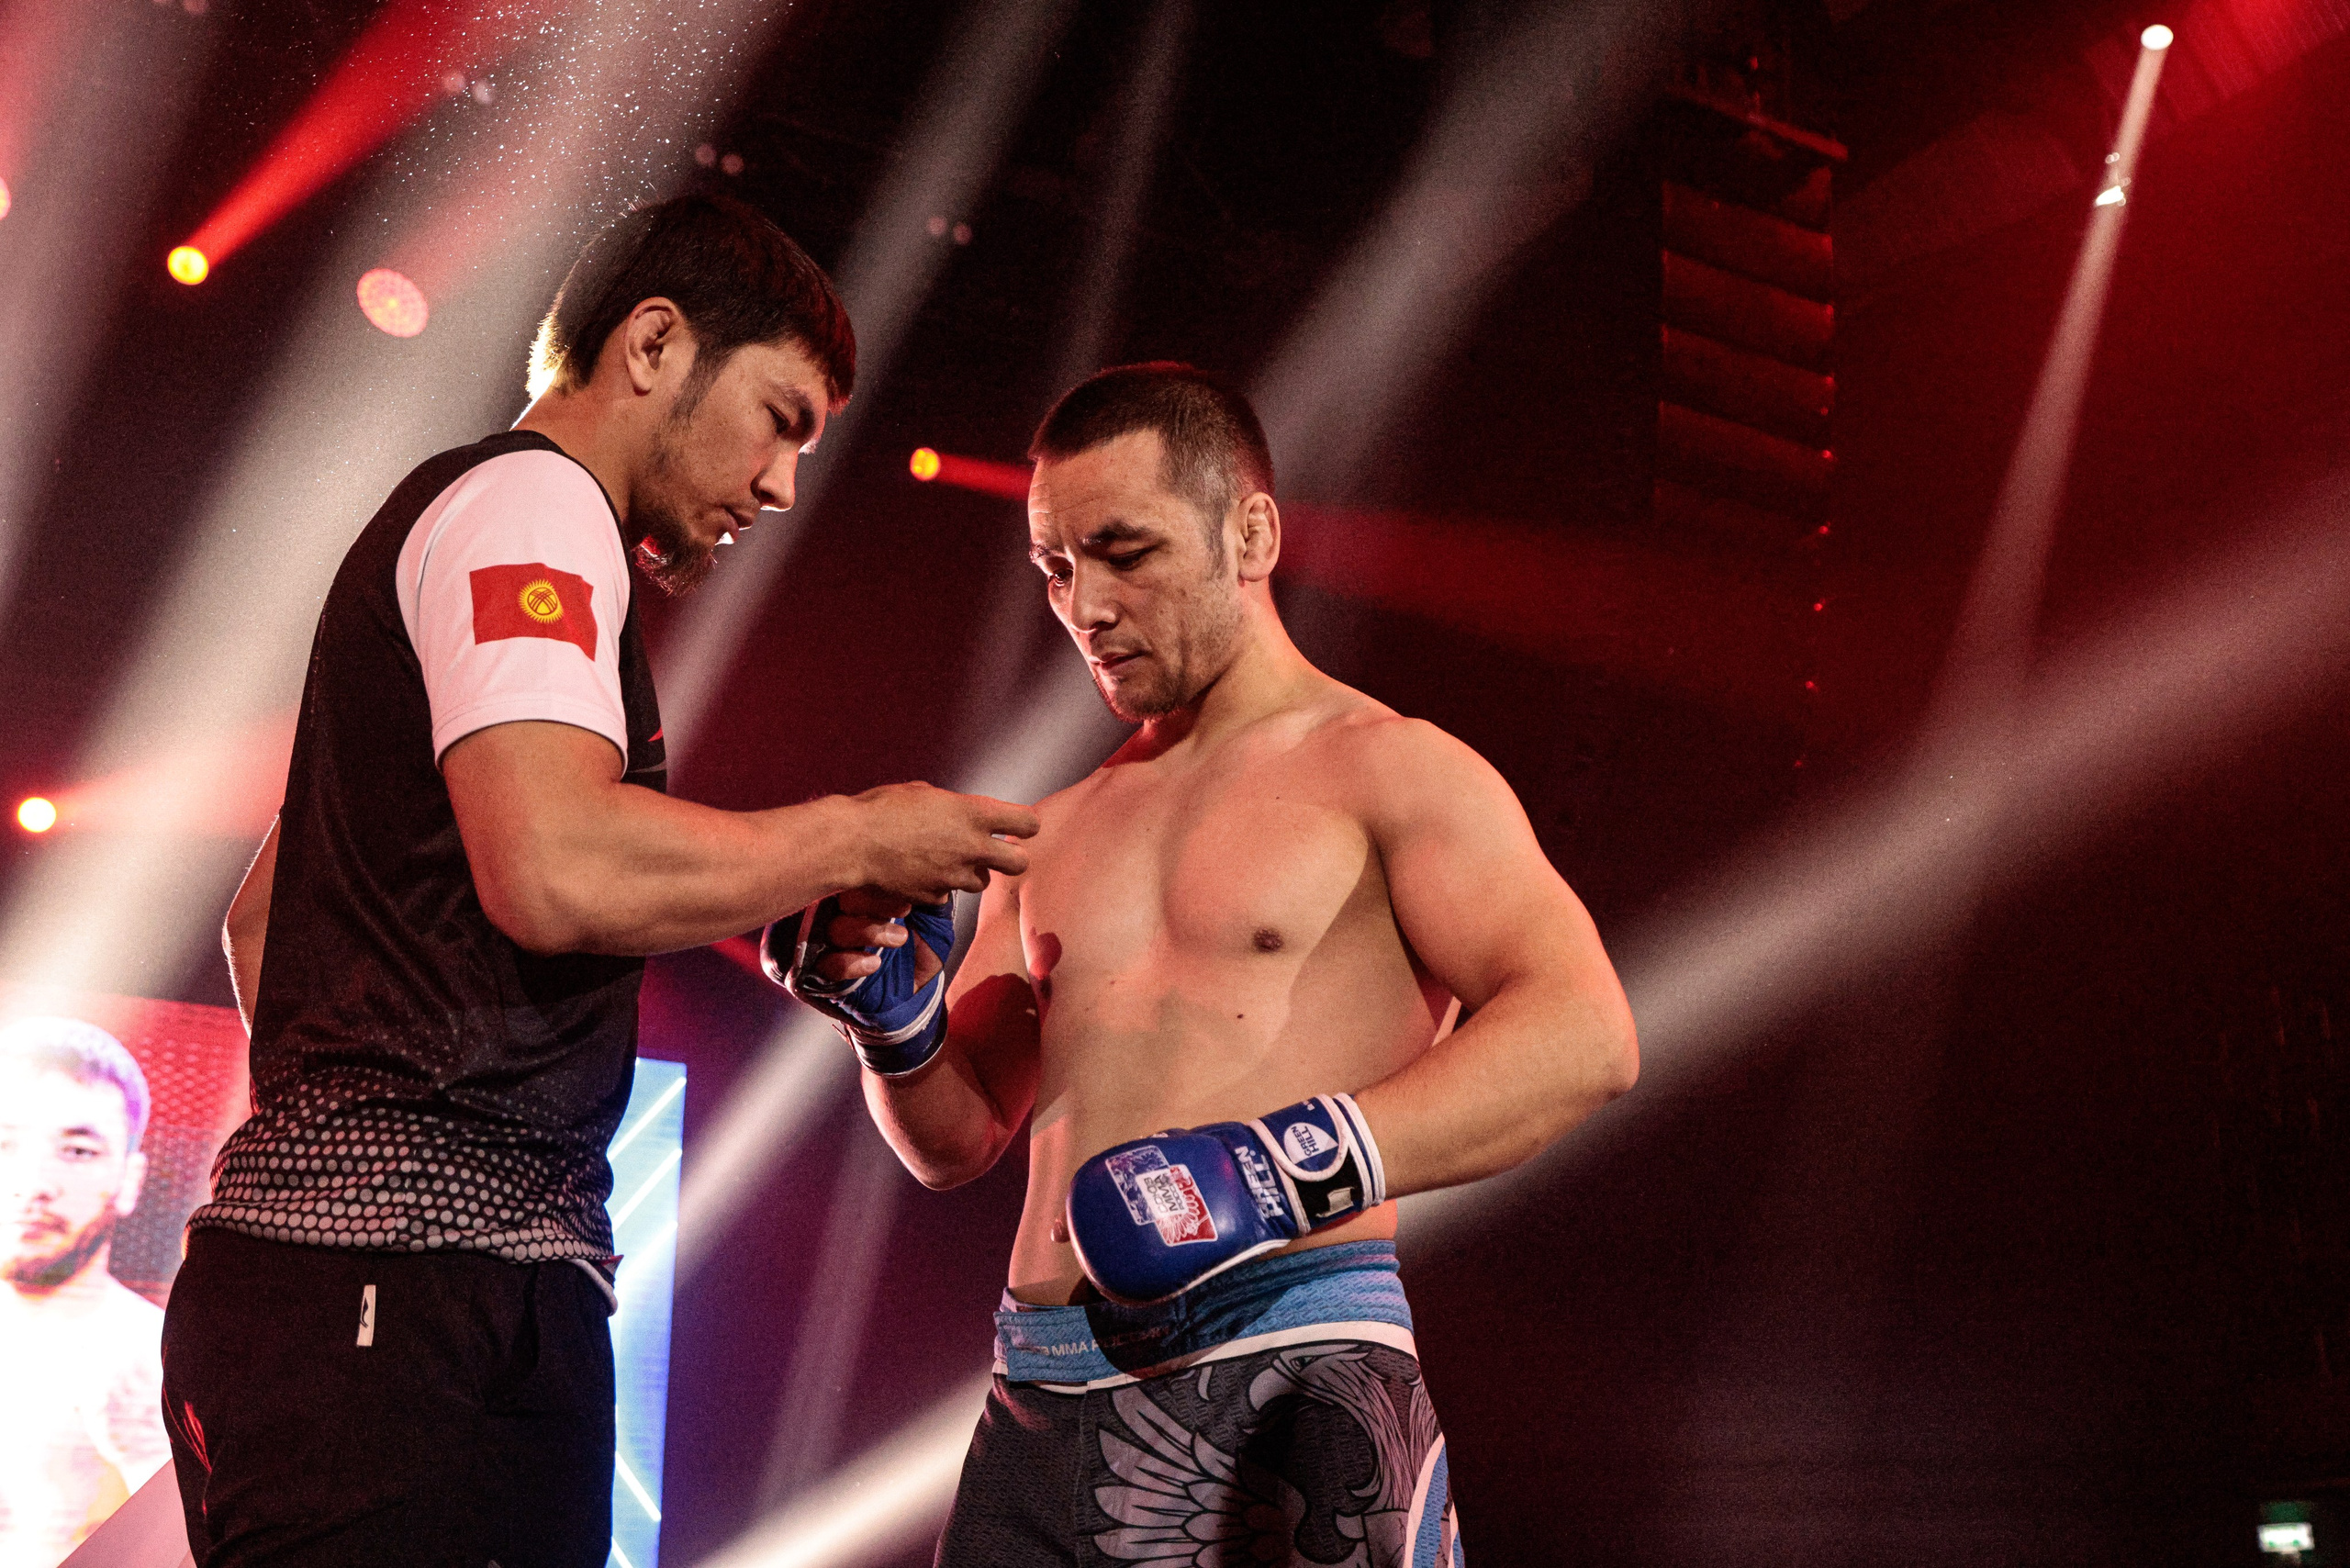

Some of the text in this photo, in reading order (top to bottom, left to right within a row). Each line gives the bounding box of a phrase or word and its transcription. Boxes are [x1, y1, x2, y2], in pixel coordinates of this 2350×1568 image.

[1291, 1126, 1312, 1157] GREEN
[1302, 1126, 1319, 1153] HILL
[1254, 1154, 1284, 1216] HILL
